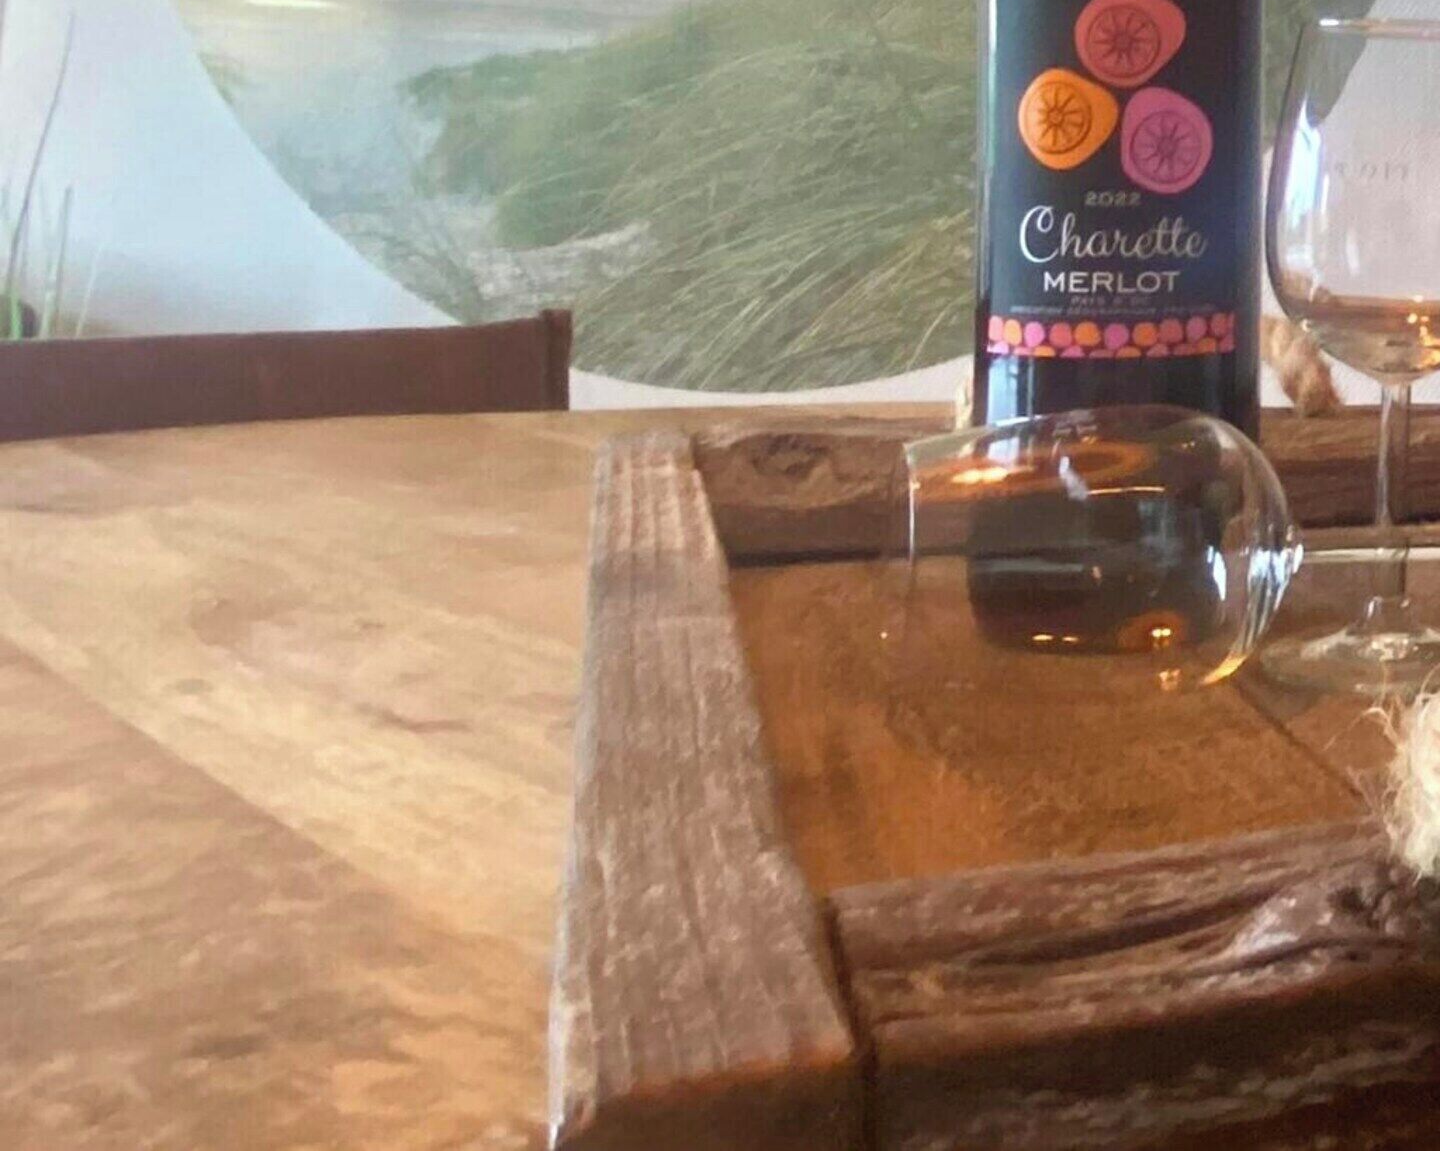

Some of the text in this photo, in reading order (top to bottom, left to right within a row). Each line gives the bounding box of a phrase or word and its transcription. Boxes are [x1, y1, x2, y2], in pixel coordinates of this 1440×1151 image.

[1085, 191, 1142, 206] 2022
[1019, 205, 1207, 263] Charette
[1043, 271, 1181, 293] MERLOT
